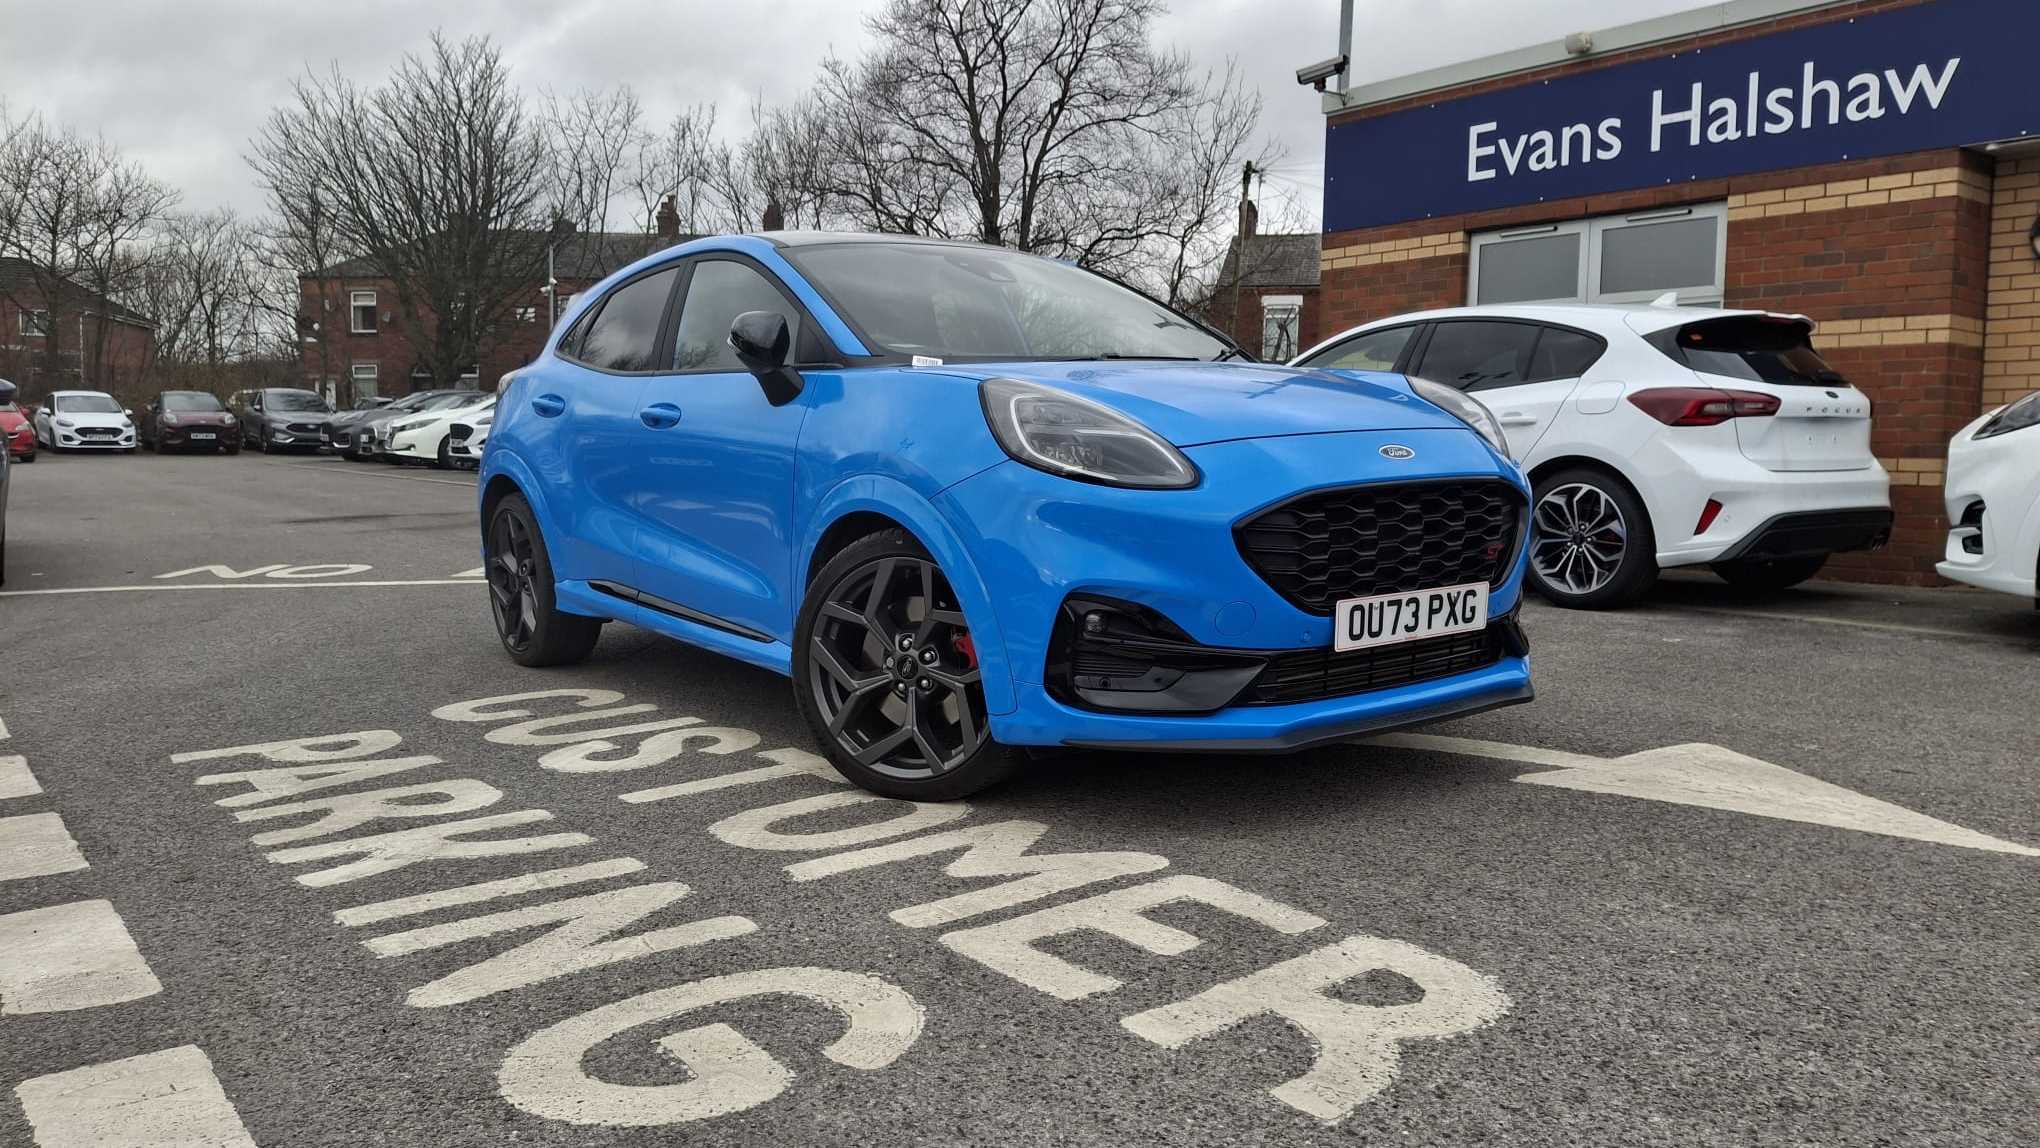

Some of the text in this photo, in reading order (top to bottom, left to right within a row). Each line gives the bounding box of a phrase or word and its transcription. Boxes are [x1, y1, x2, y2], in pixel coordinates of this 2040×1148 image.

[1467, 58, 1961, 182] Evans Halshaw
[152, 564, 373, 578] NO
[1348, 589, 1477, 641] OU73 PXG
[170, 729, 925, 1127] PARKING
[430, 688, 1512, 1125] CUSTOMER
